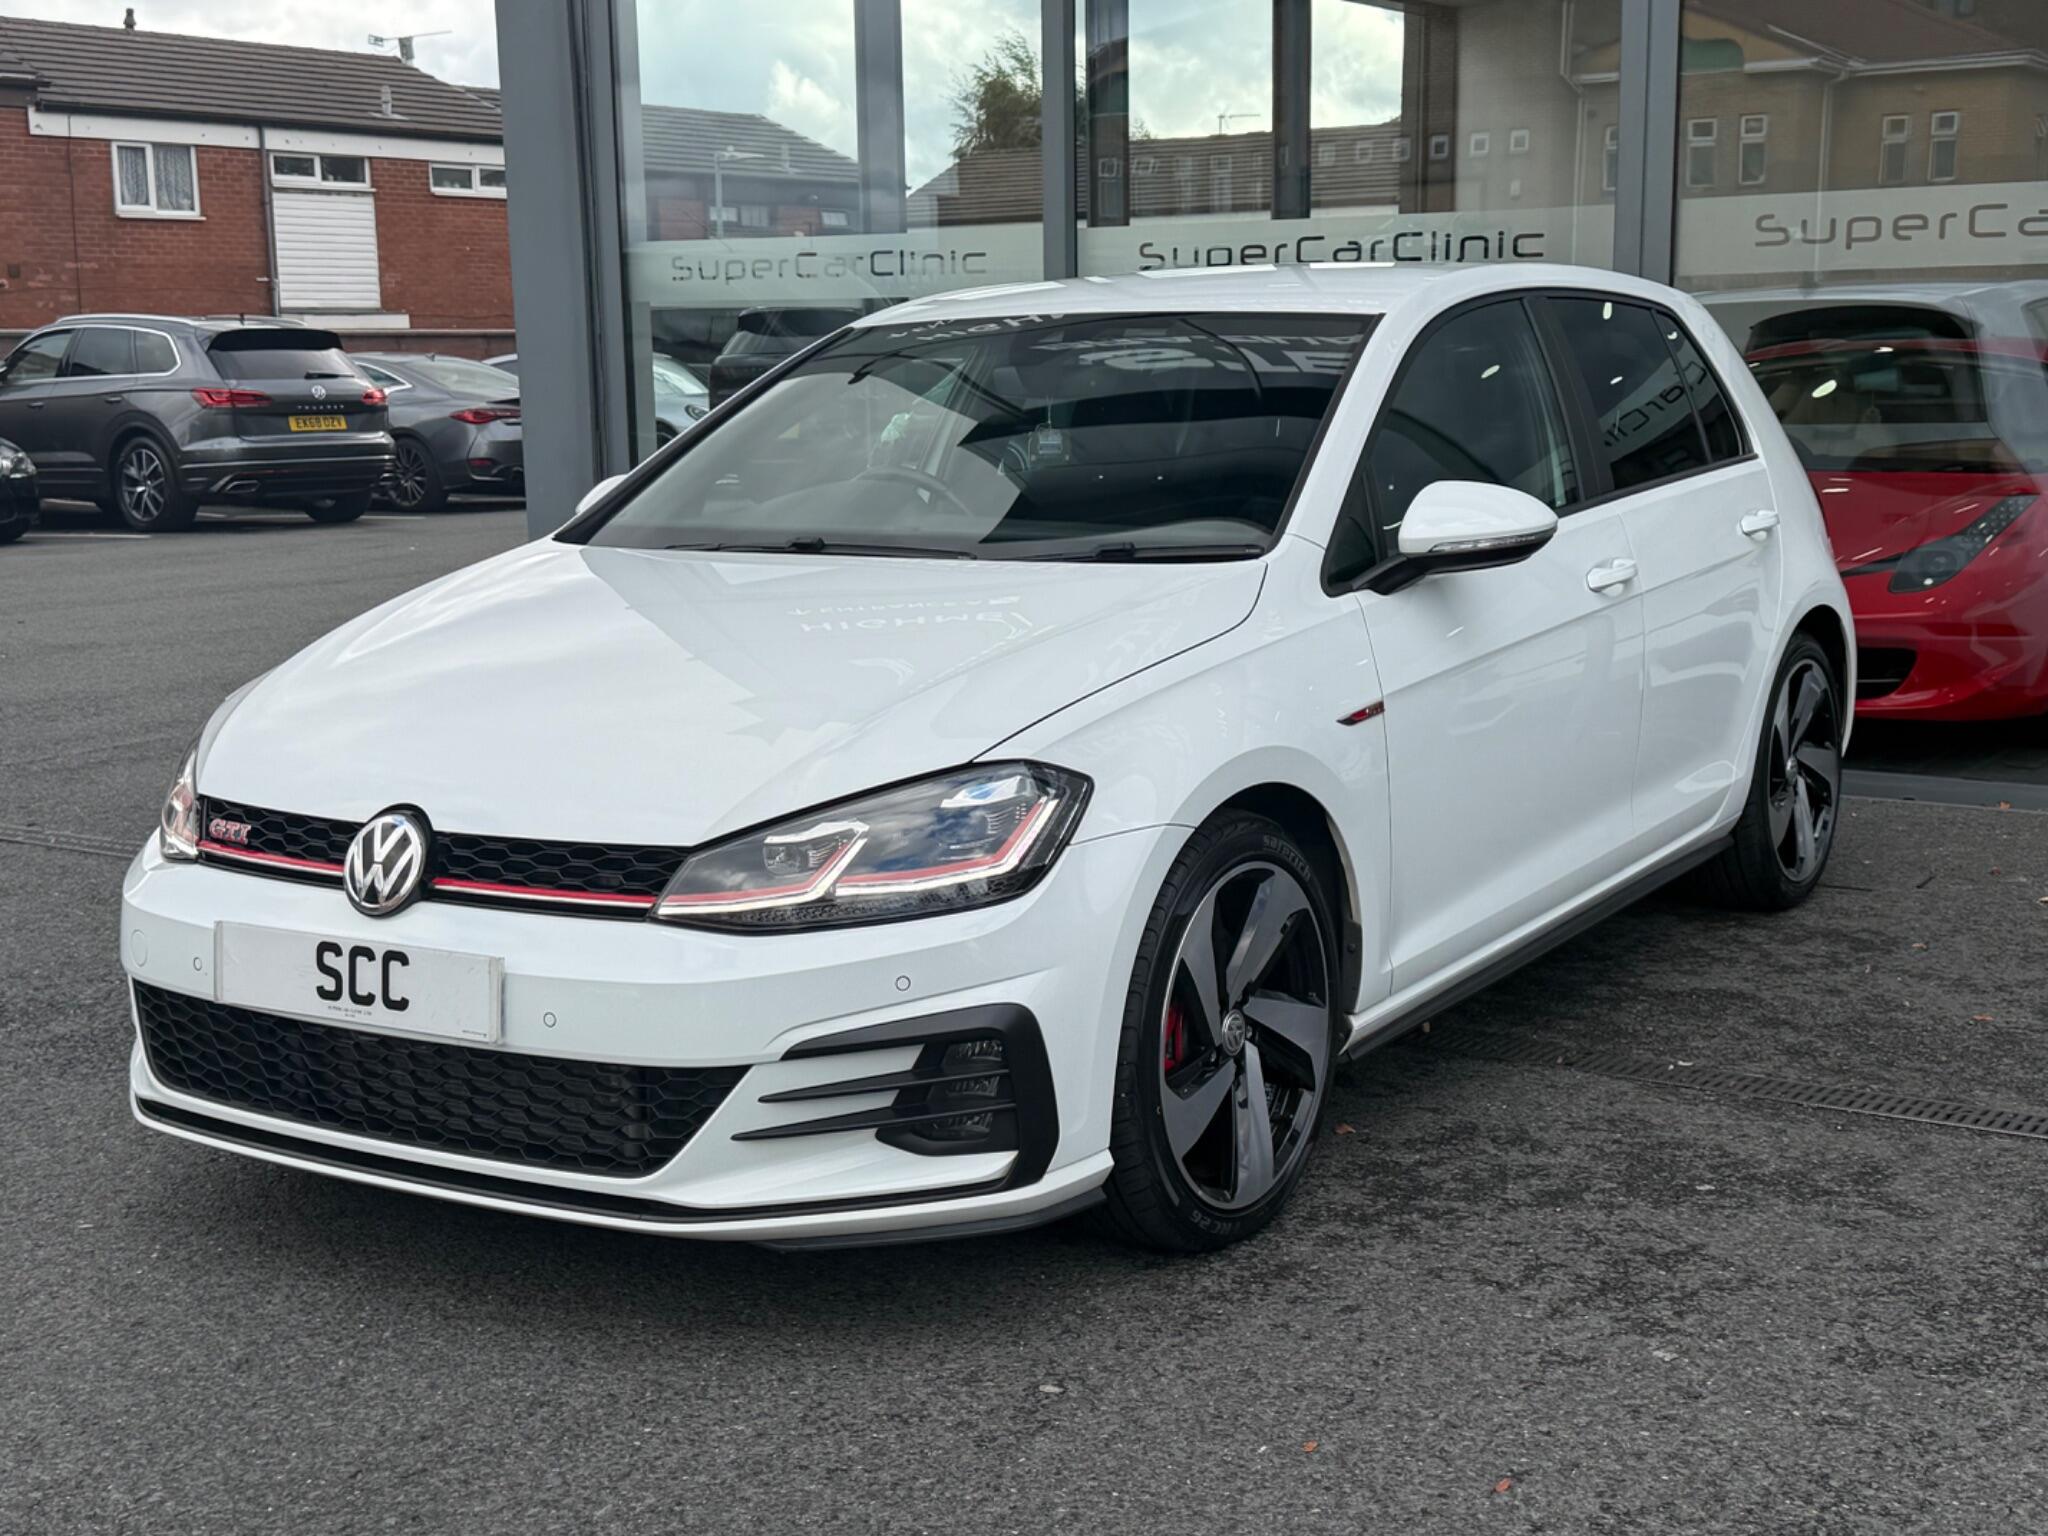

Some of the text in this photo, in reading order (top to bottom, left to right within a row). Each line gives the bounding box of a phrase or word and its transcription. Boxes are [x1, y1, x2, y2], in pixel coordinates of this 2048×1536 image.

[671, 249, 987, 285] SuperCarClinic
[1138, 231, 1545, 271] SuperCarClinic
[208, 817, 252, 845] GTI
[316, 941, 410, 1012] SCC
